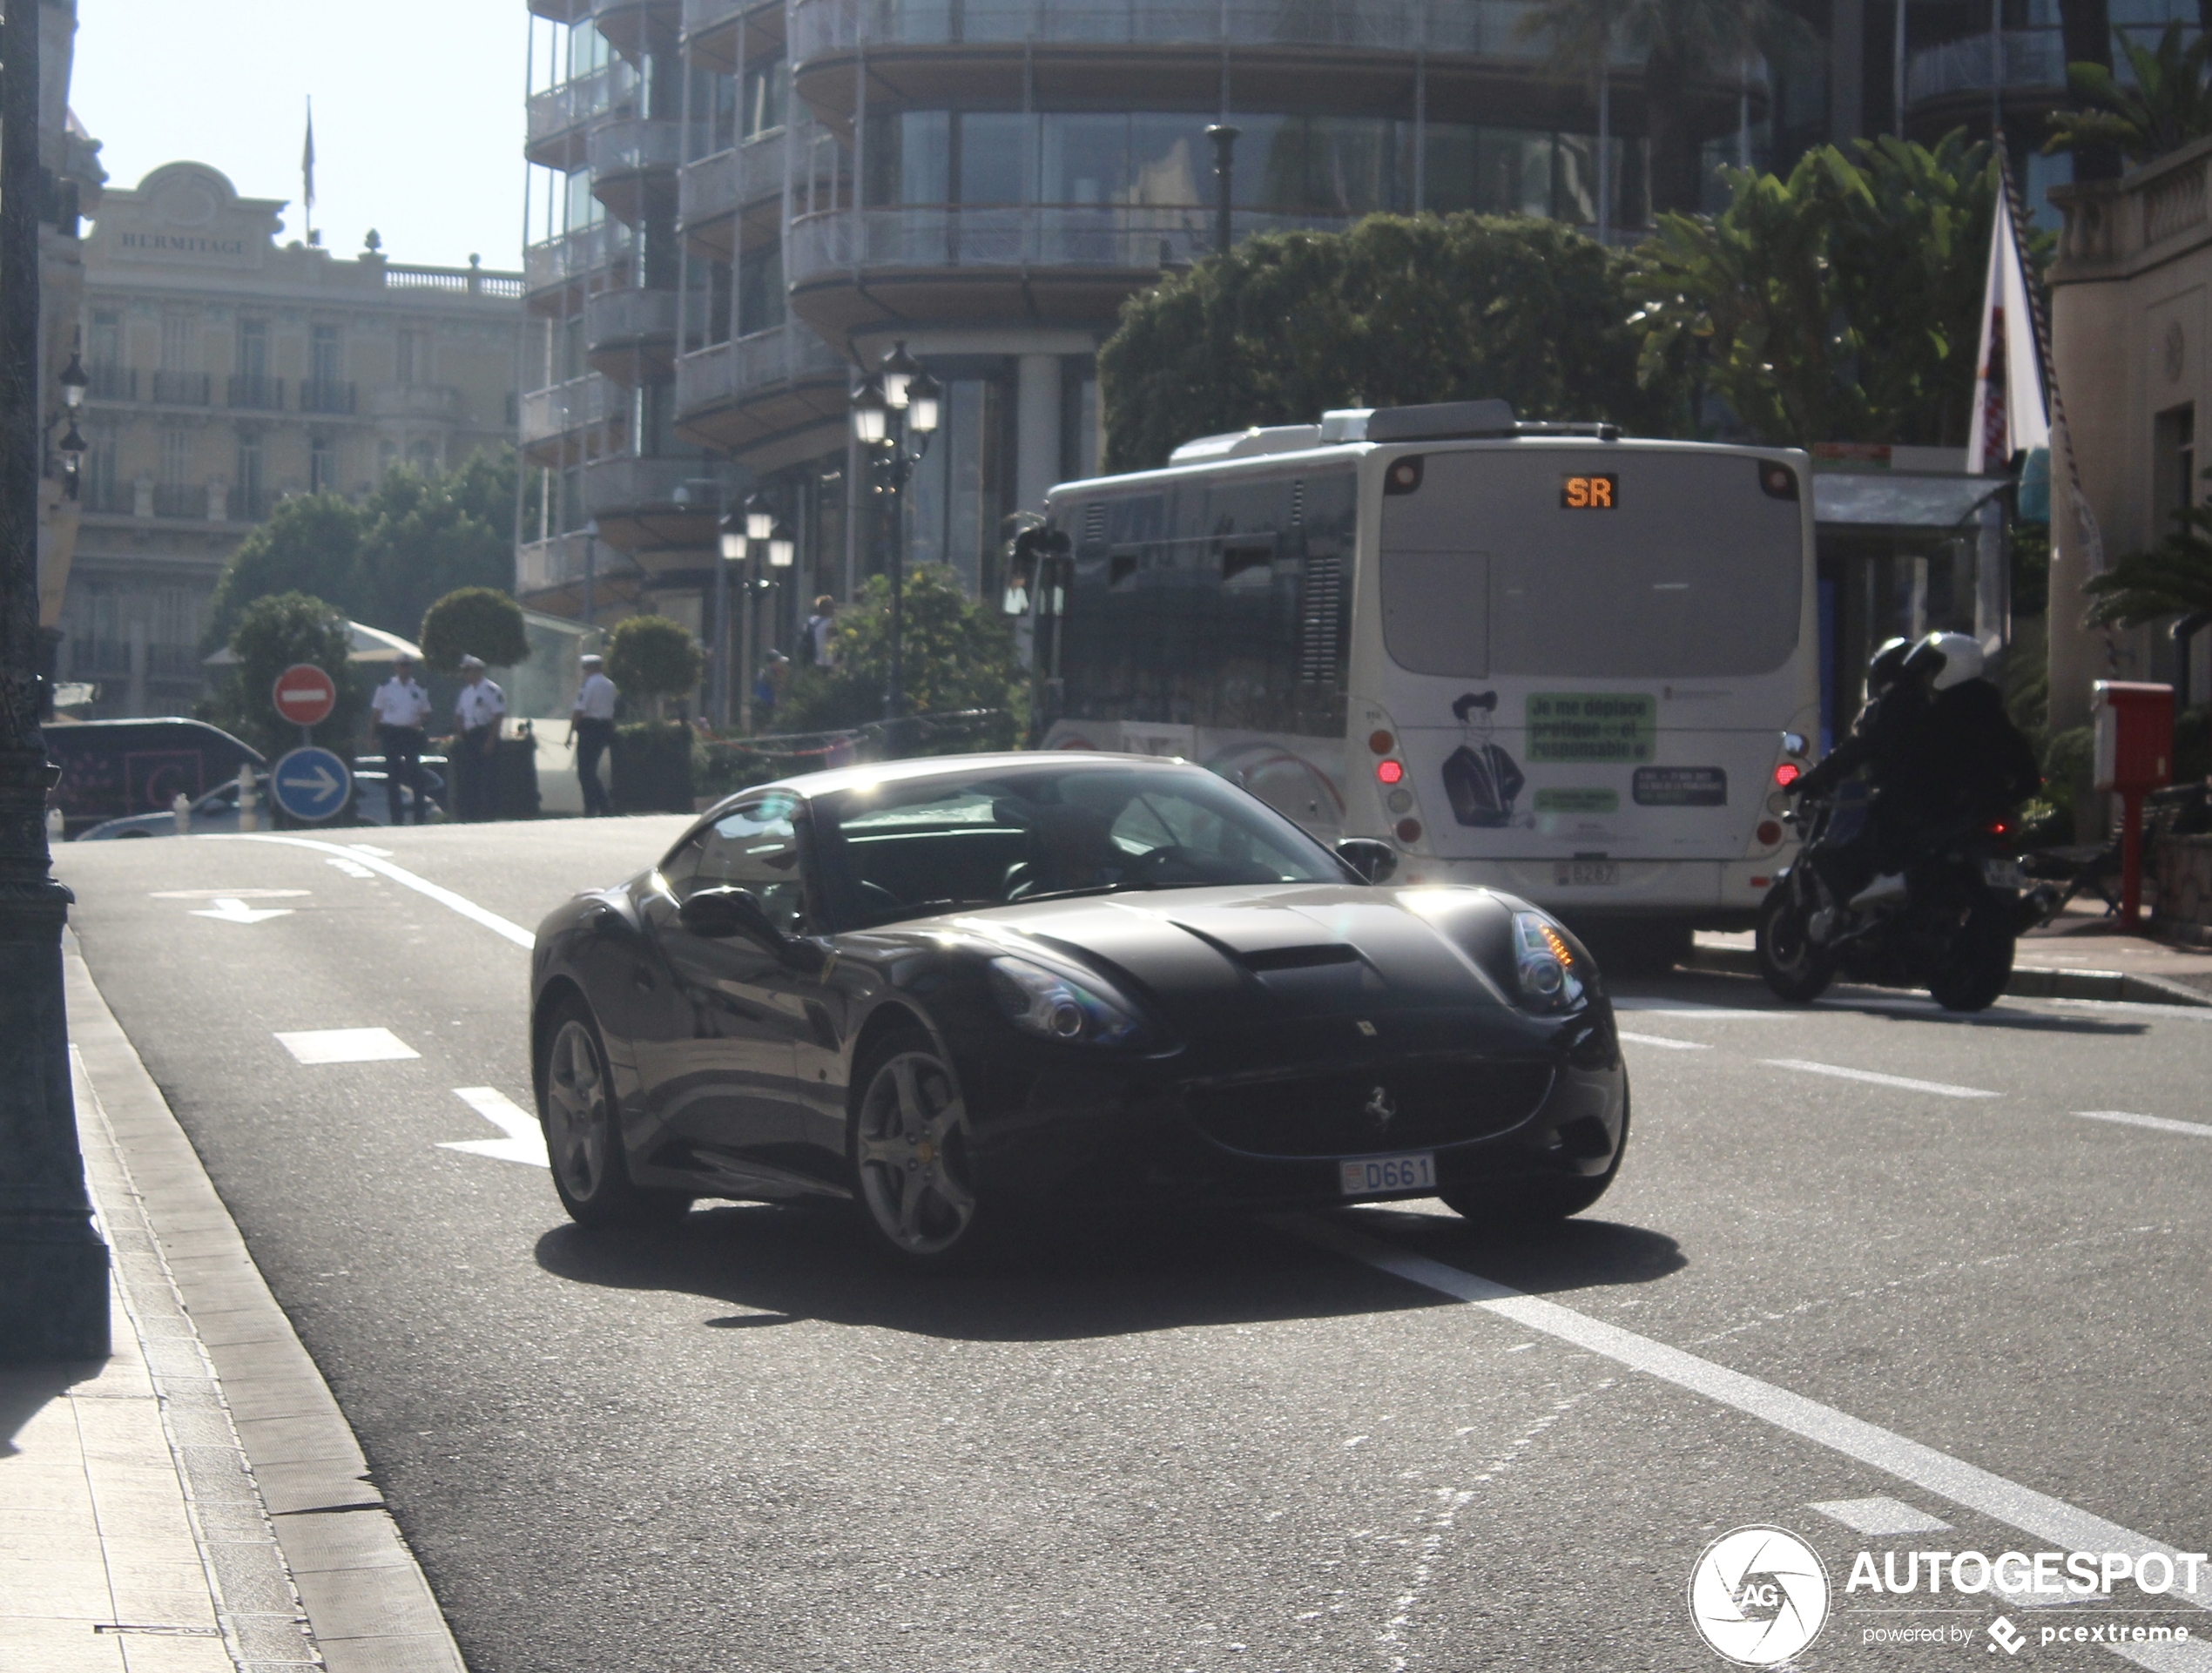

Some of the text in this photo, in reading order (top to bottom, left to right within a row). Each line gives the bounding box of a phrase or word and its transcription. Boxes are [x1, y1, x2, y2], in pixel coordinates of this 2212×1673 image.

[122, 232, 244, 254] HERMITAGE
[1568, 477, 1611, 507] SR
[1533, 698, 1551, 716] Je
[1555, 700, 1580, 716] me
[1532, 739, 1629, 758] responsable
[1366, 1158, 1429, 1189] D661
